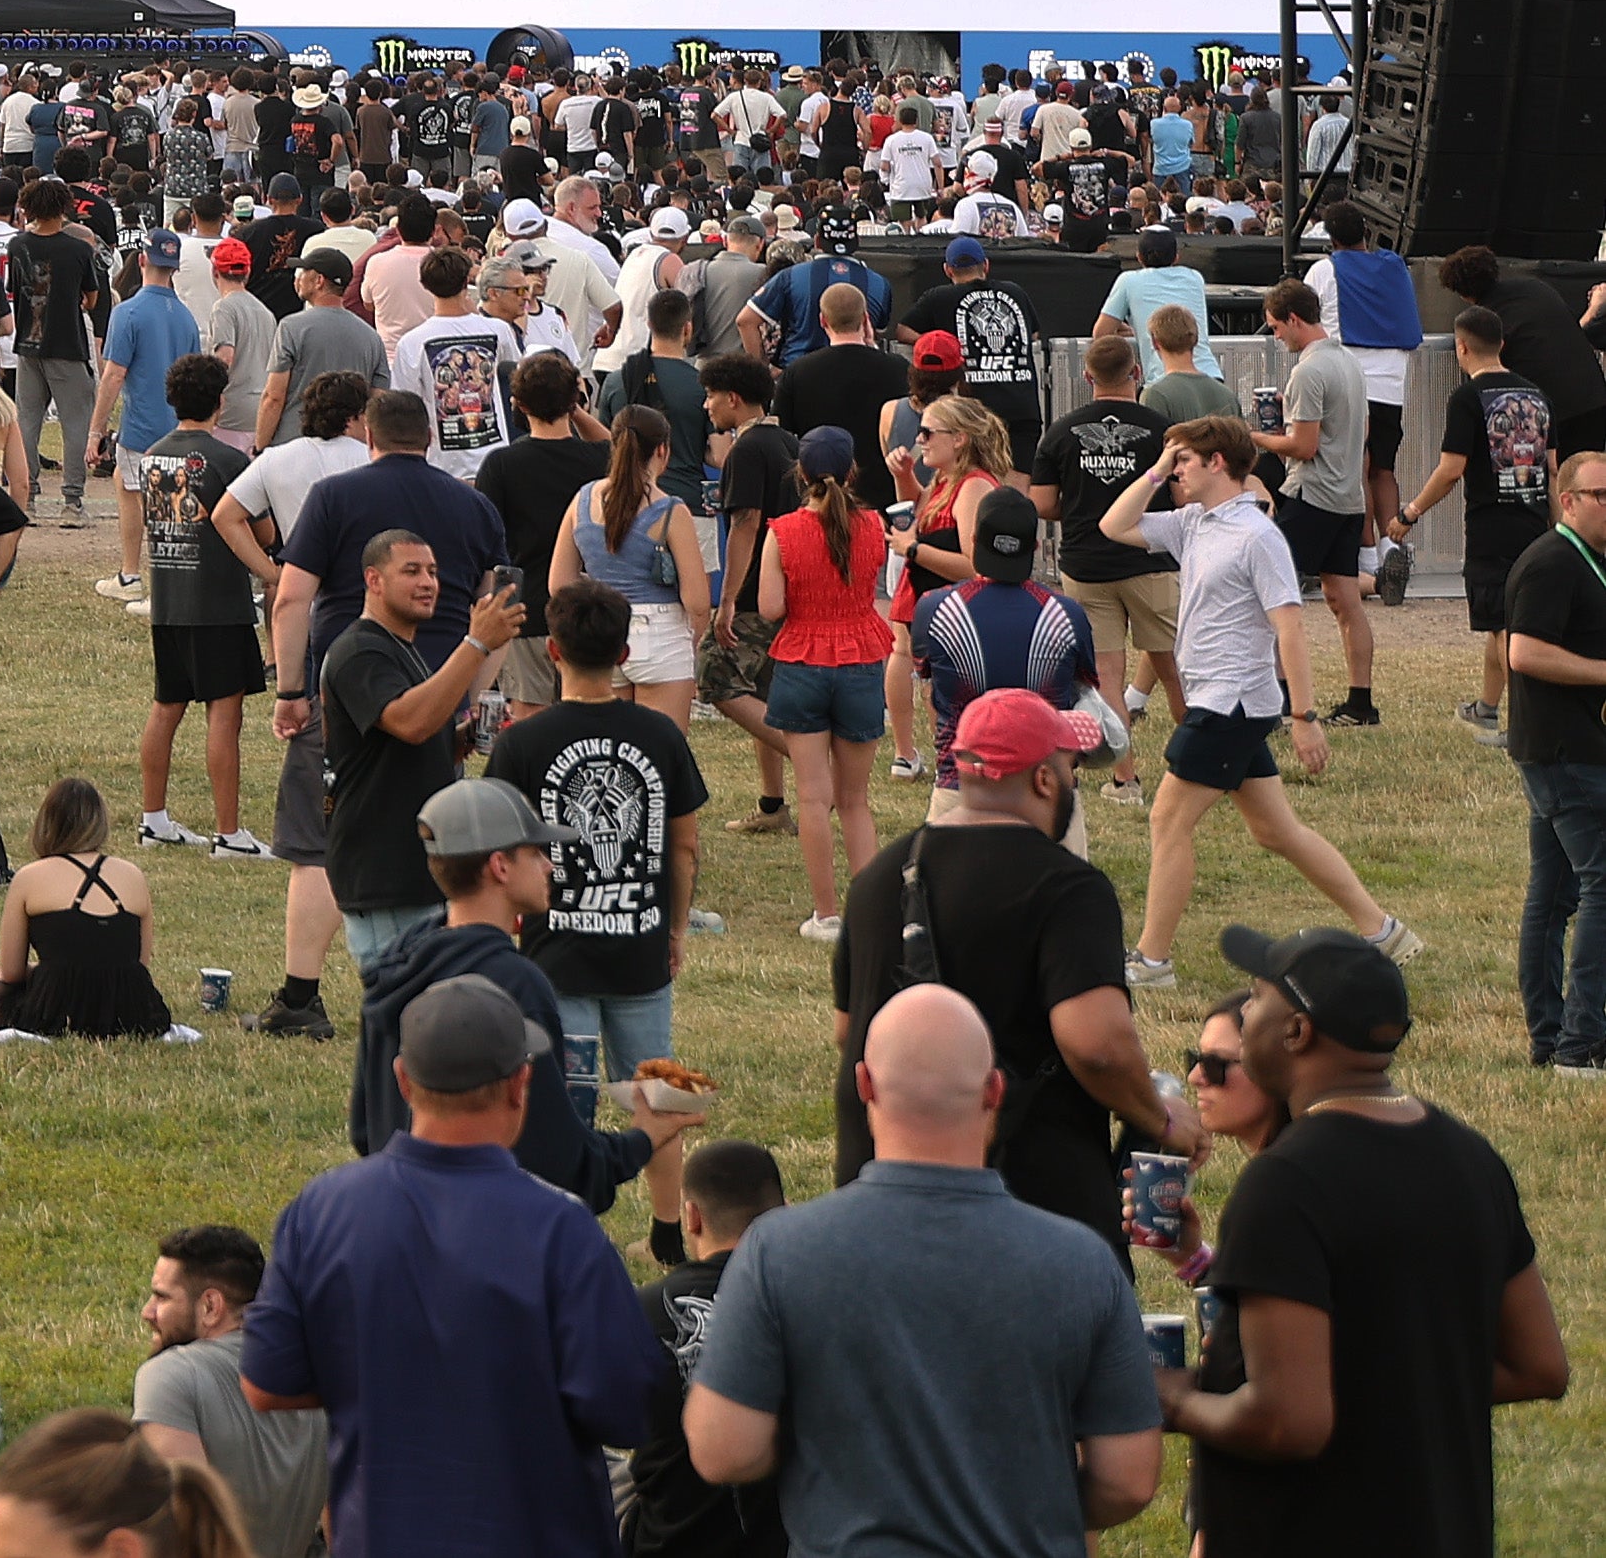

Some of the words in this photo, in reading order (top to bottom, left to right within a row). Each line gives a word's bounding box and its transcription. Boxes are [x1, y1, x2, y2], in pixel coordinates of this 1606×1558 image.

[406, 48, 471, 62] MONSTER
[980, 356, 1015, 370] UFC
[965, 370, 1013, 383] FREEDOM
[1015, 369, 1032, 382] 250
[1080, 455, 1135, 471] HUXWRX
[583, 767, 620, 789] 250
[545, 738, 613, 787] FIGHTING
[617, 741, 666, 854] CHAMPIONSHIP
[578, 882, 642, 911] UFC
[548, 909, 635, 934] FREEDOM
[639, 905, 661, 932] 250
